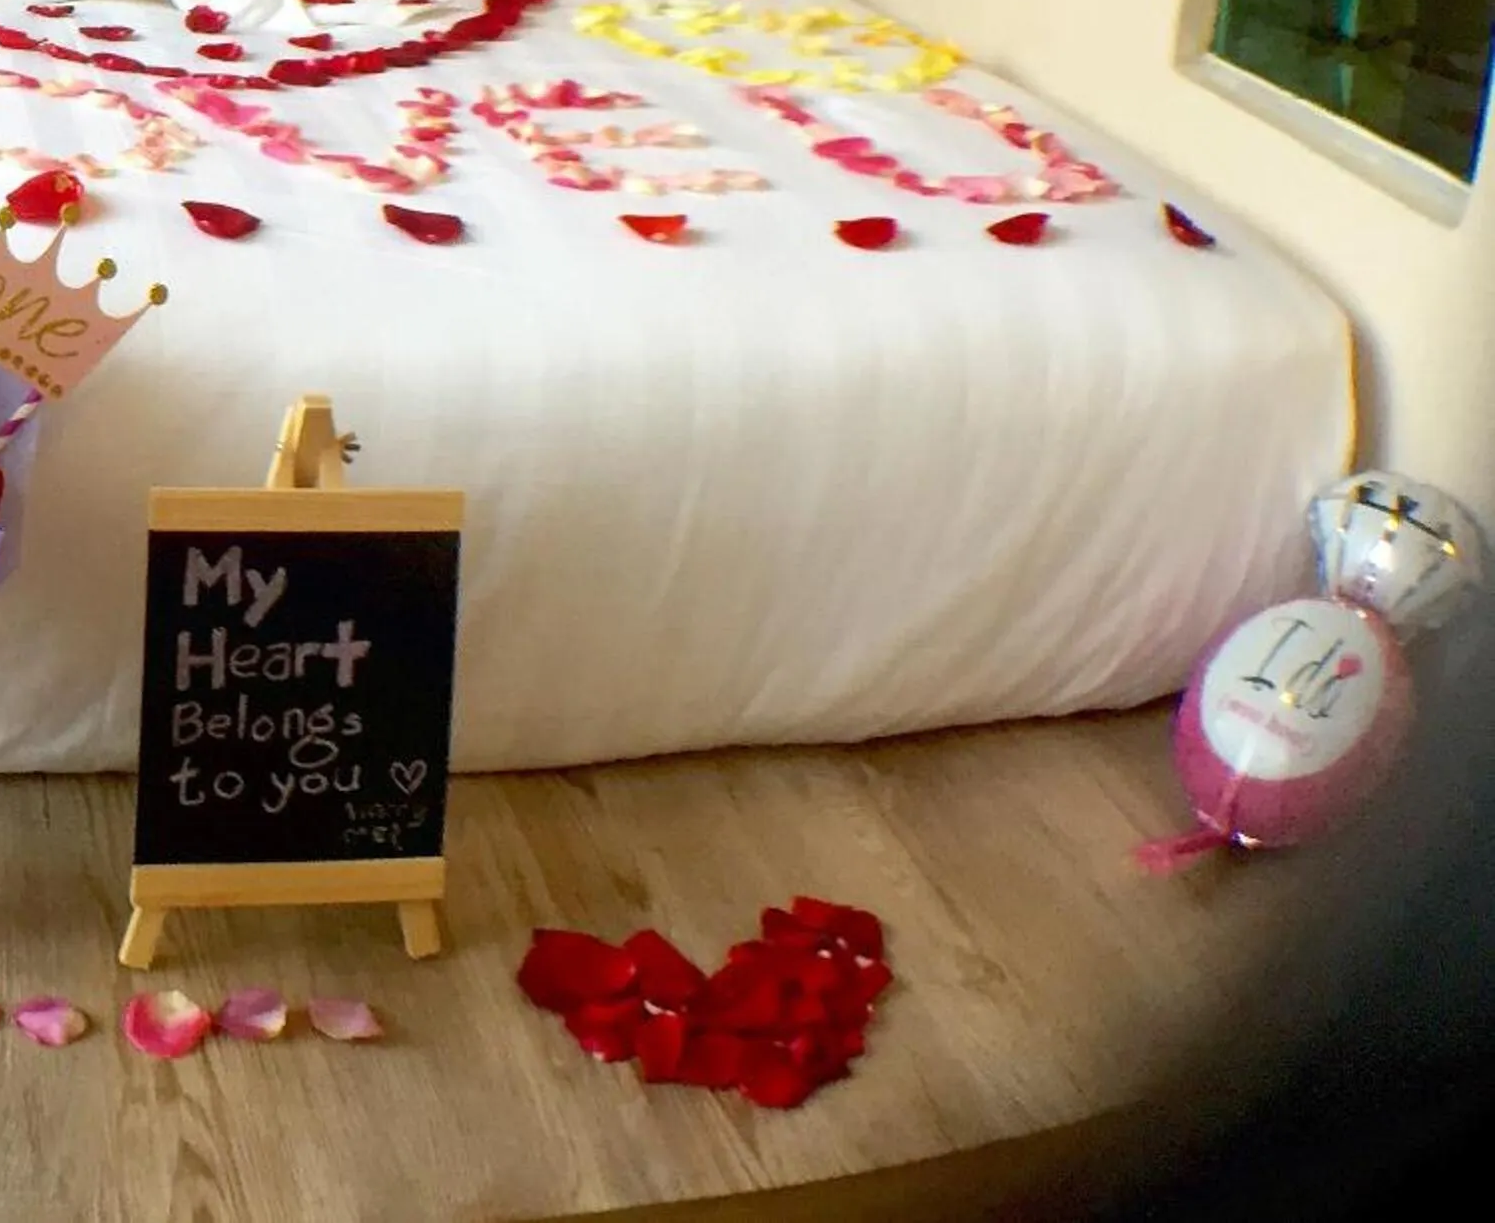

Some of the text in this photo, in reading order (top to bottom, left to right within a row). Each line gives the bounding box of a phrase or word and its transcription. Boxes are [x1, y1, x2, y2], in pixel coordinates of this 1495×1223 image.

[181, 544, 288, 628] My
[175, 619, 372, 692] Heart
[171, 692, 364, 769] Belongs
[169, 755, 363, 815] to you
